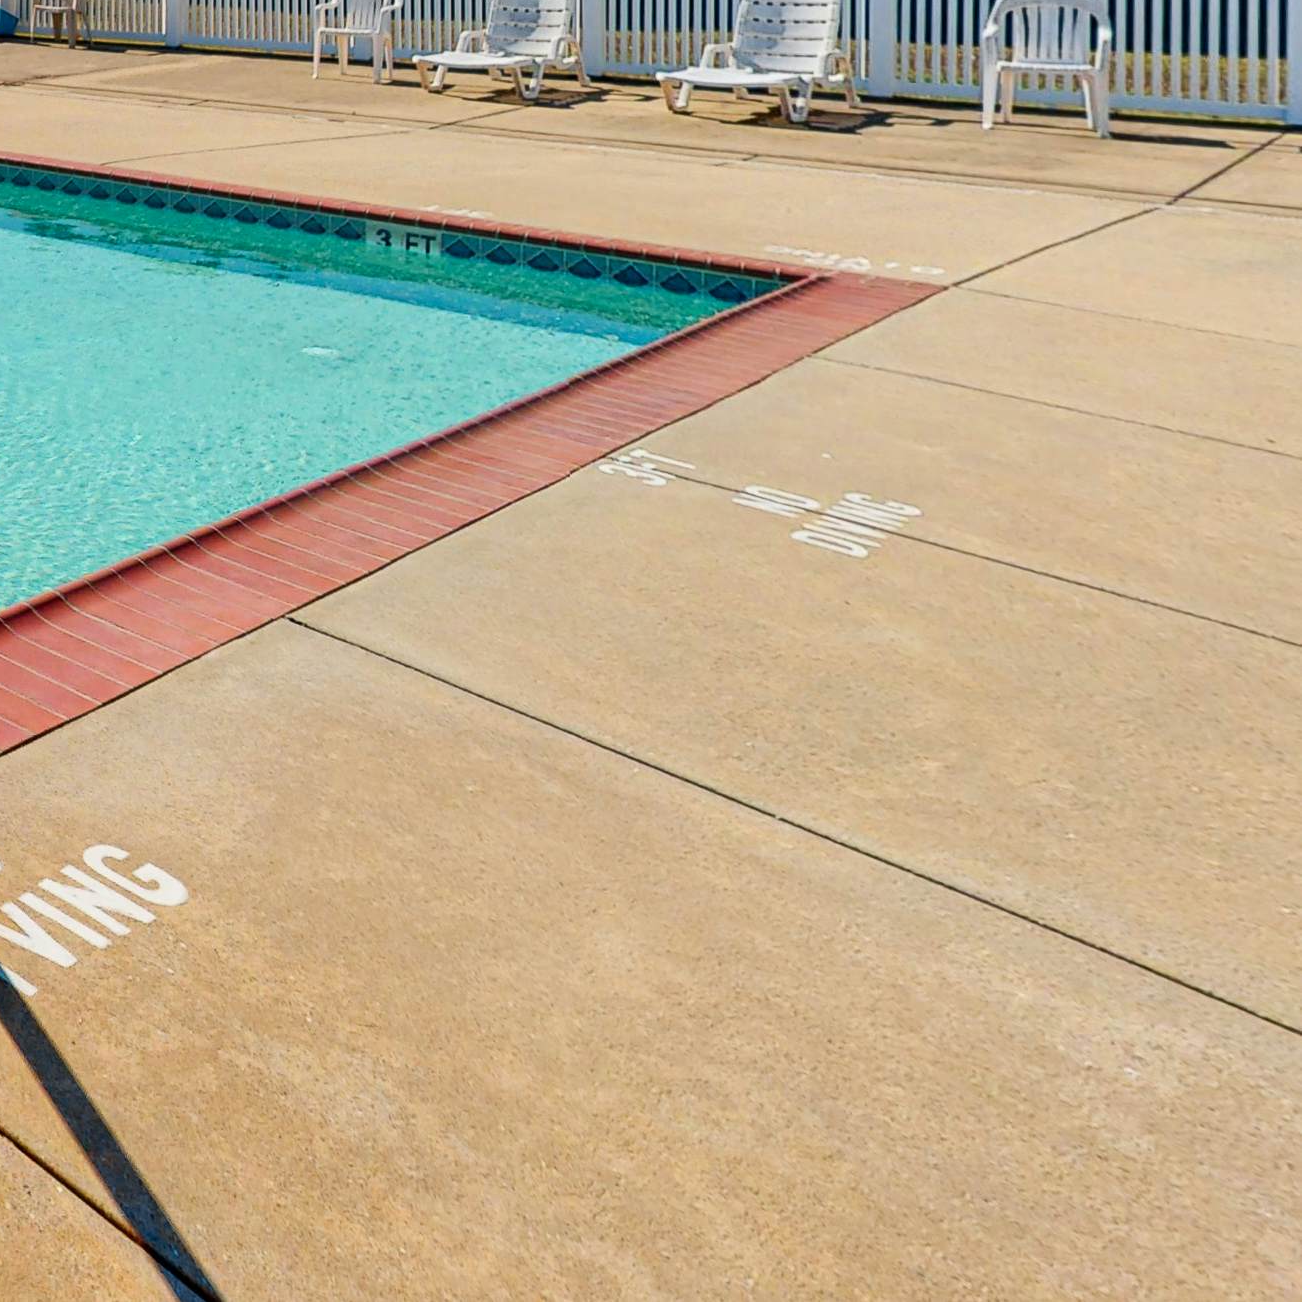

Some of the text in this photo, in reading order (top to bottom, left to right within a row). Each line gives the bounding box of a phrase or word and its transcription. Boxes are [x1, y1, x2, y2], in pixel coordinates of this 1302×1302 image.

[376, 228, 436, 254] 3 FT
[731, 485, 821, 518] NO
[790, 492, 924, 559] DIVING
